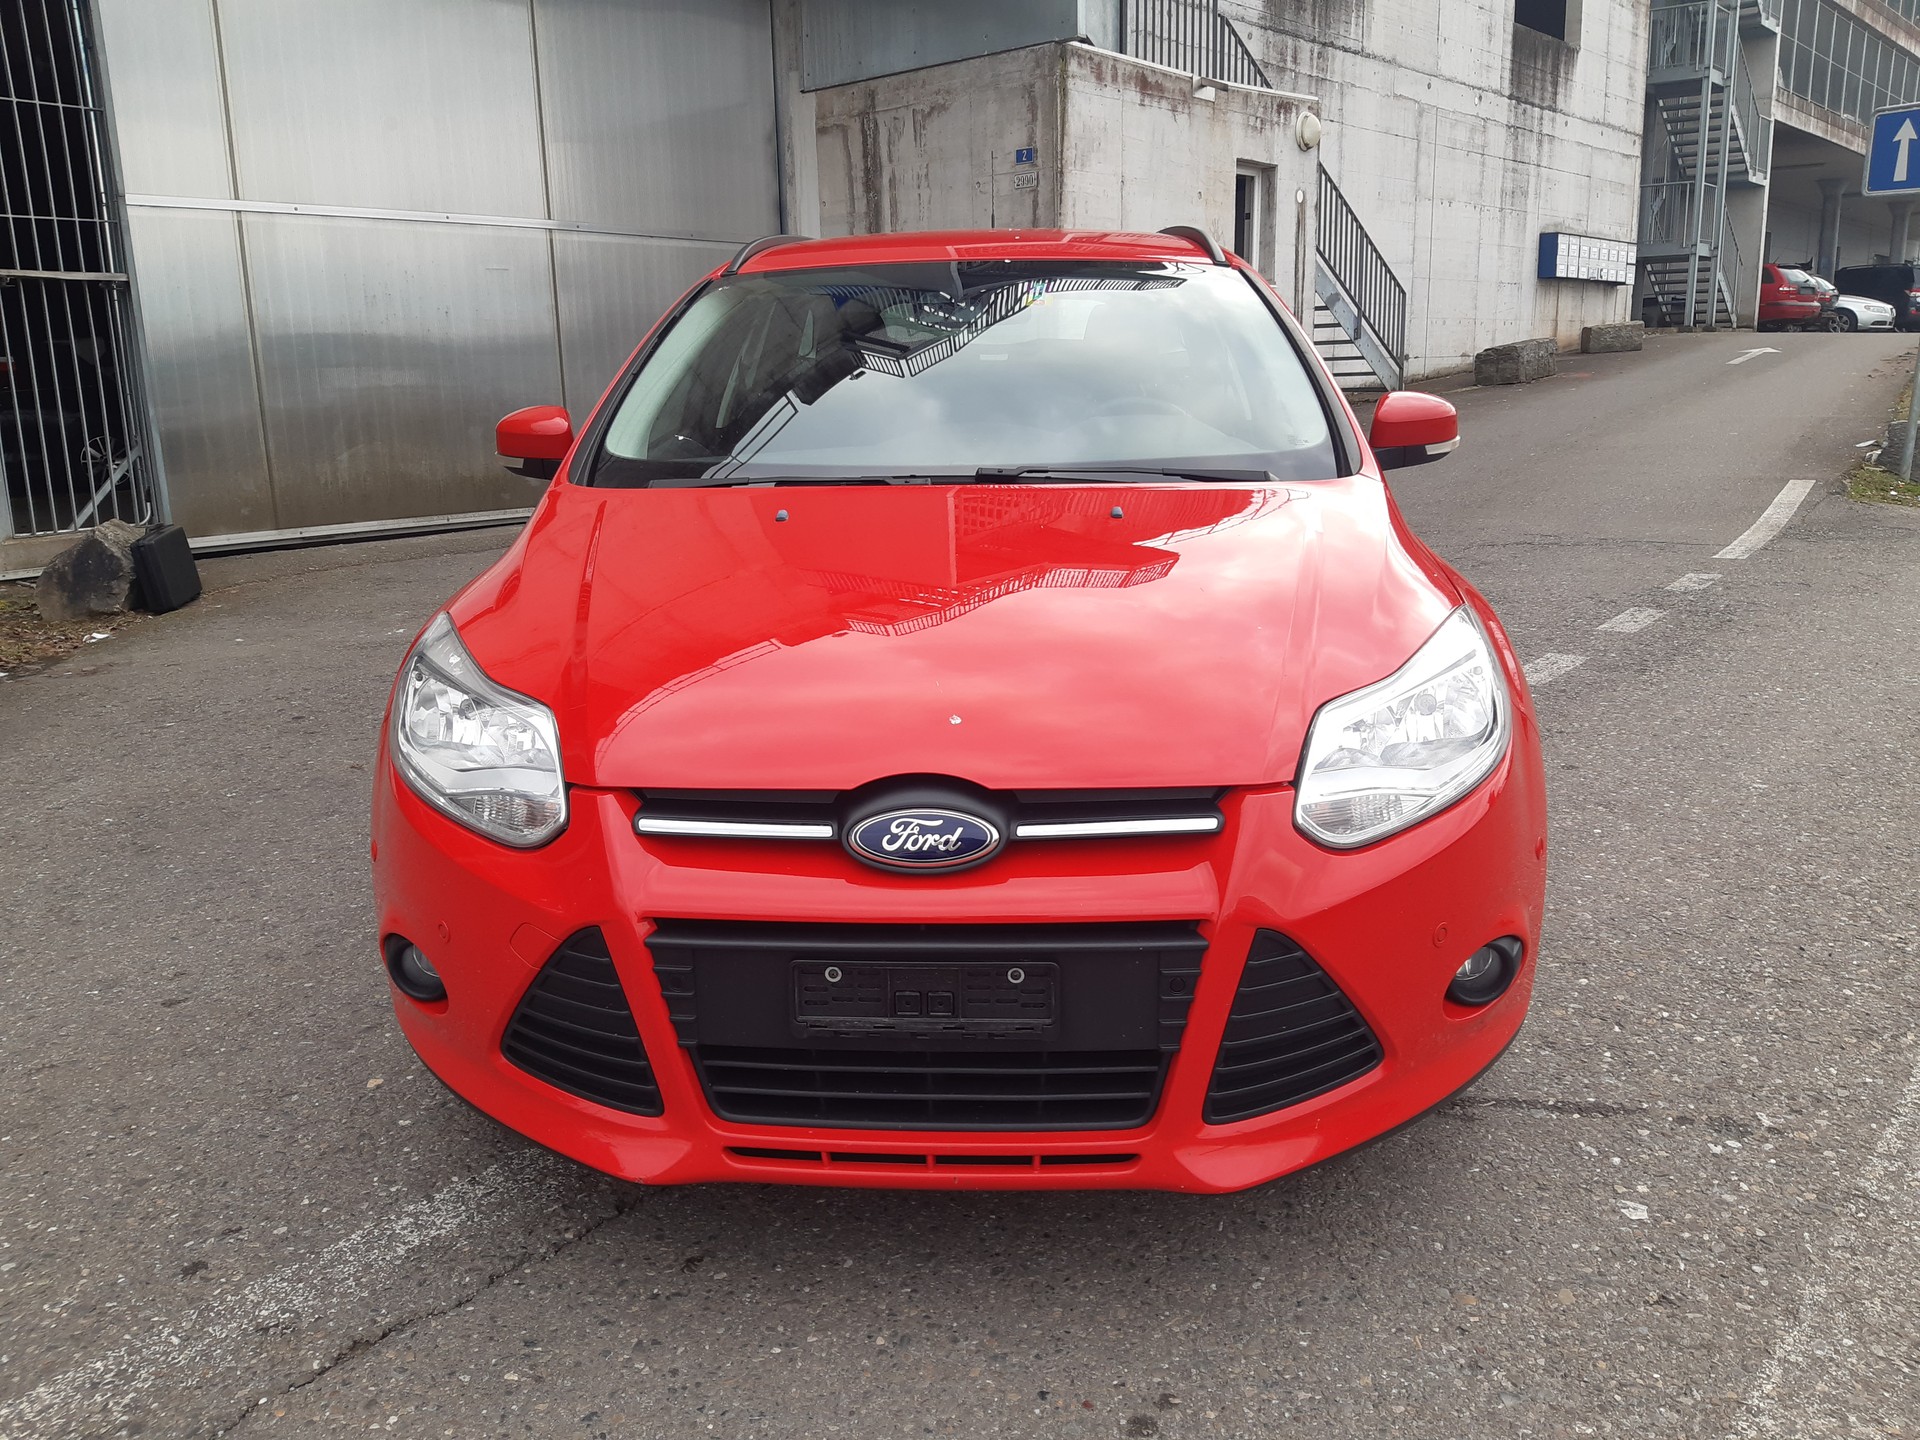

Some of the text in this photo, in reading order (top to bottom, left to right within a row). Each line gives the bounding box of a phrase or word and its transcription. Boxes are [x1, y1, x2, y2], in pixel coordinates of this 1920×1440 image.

[1022, 150, 1027, 161] 2
[1016, 175, 1034, 187] 2990
[882, 818, 964, 851] Ford
